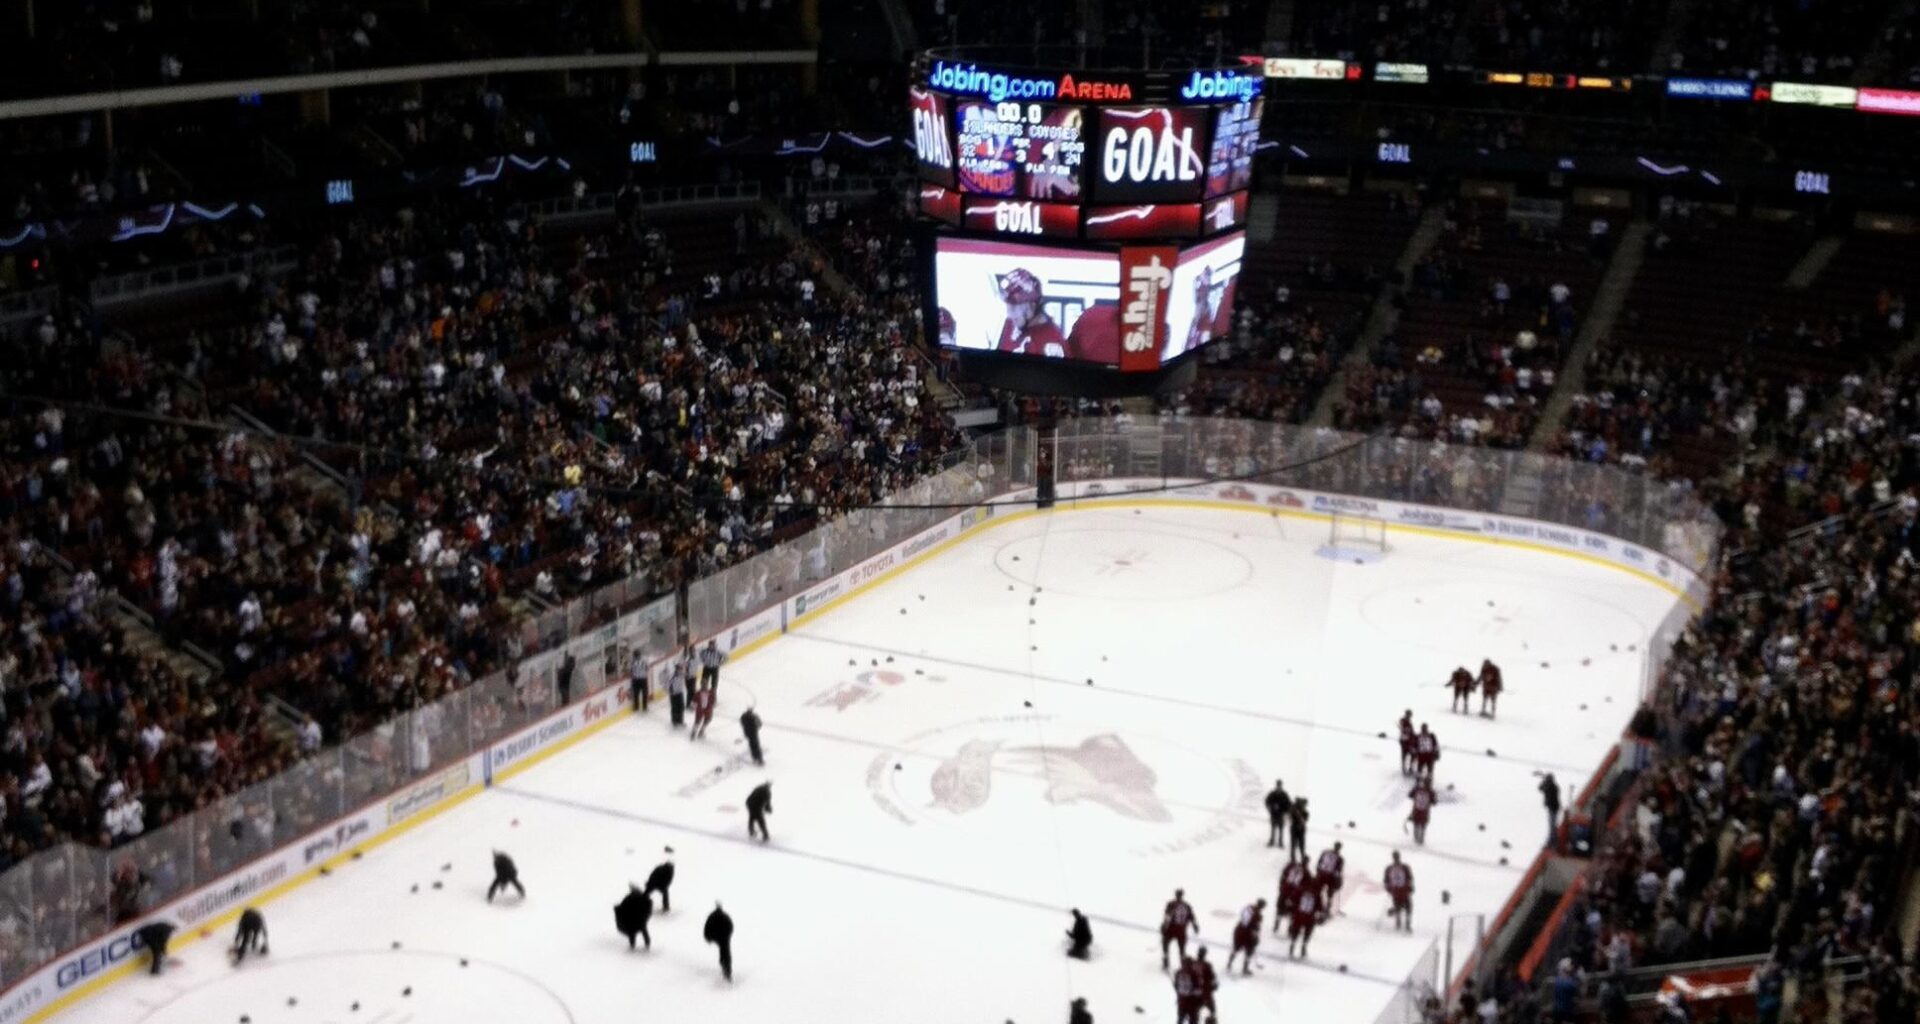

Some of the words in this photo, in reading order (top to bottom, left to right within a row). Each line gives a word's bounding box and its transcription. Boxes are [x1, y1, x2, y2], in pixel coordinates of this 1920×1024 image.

[931, 60, 1055, 101] Jobing.com
[1058, 73, 1133, 100] ARENA
[997, 102, 1042, 124] 00.0
[914, 108, 952, 168] GOAL
[1029, 125, 1080, 140] COYOTES
[631, 141, 656, 162] GOAL
[1042, 140, 1055, 161] 4
[1103, 126, 1197, 182] GOAL
[1378, 142, 1411, 162] GOAL
[328, 178, 354, 204] GOAL
[1795, 170, 1830, 194] GOAL
[995, 201, 1043, 234] GOAL
[861, 553, 895, 579] TOYOTA
[539, 714, 574, 744] SCHOOLS
